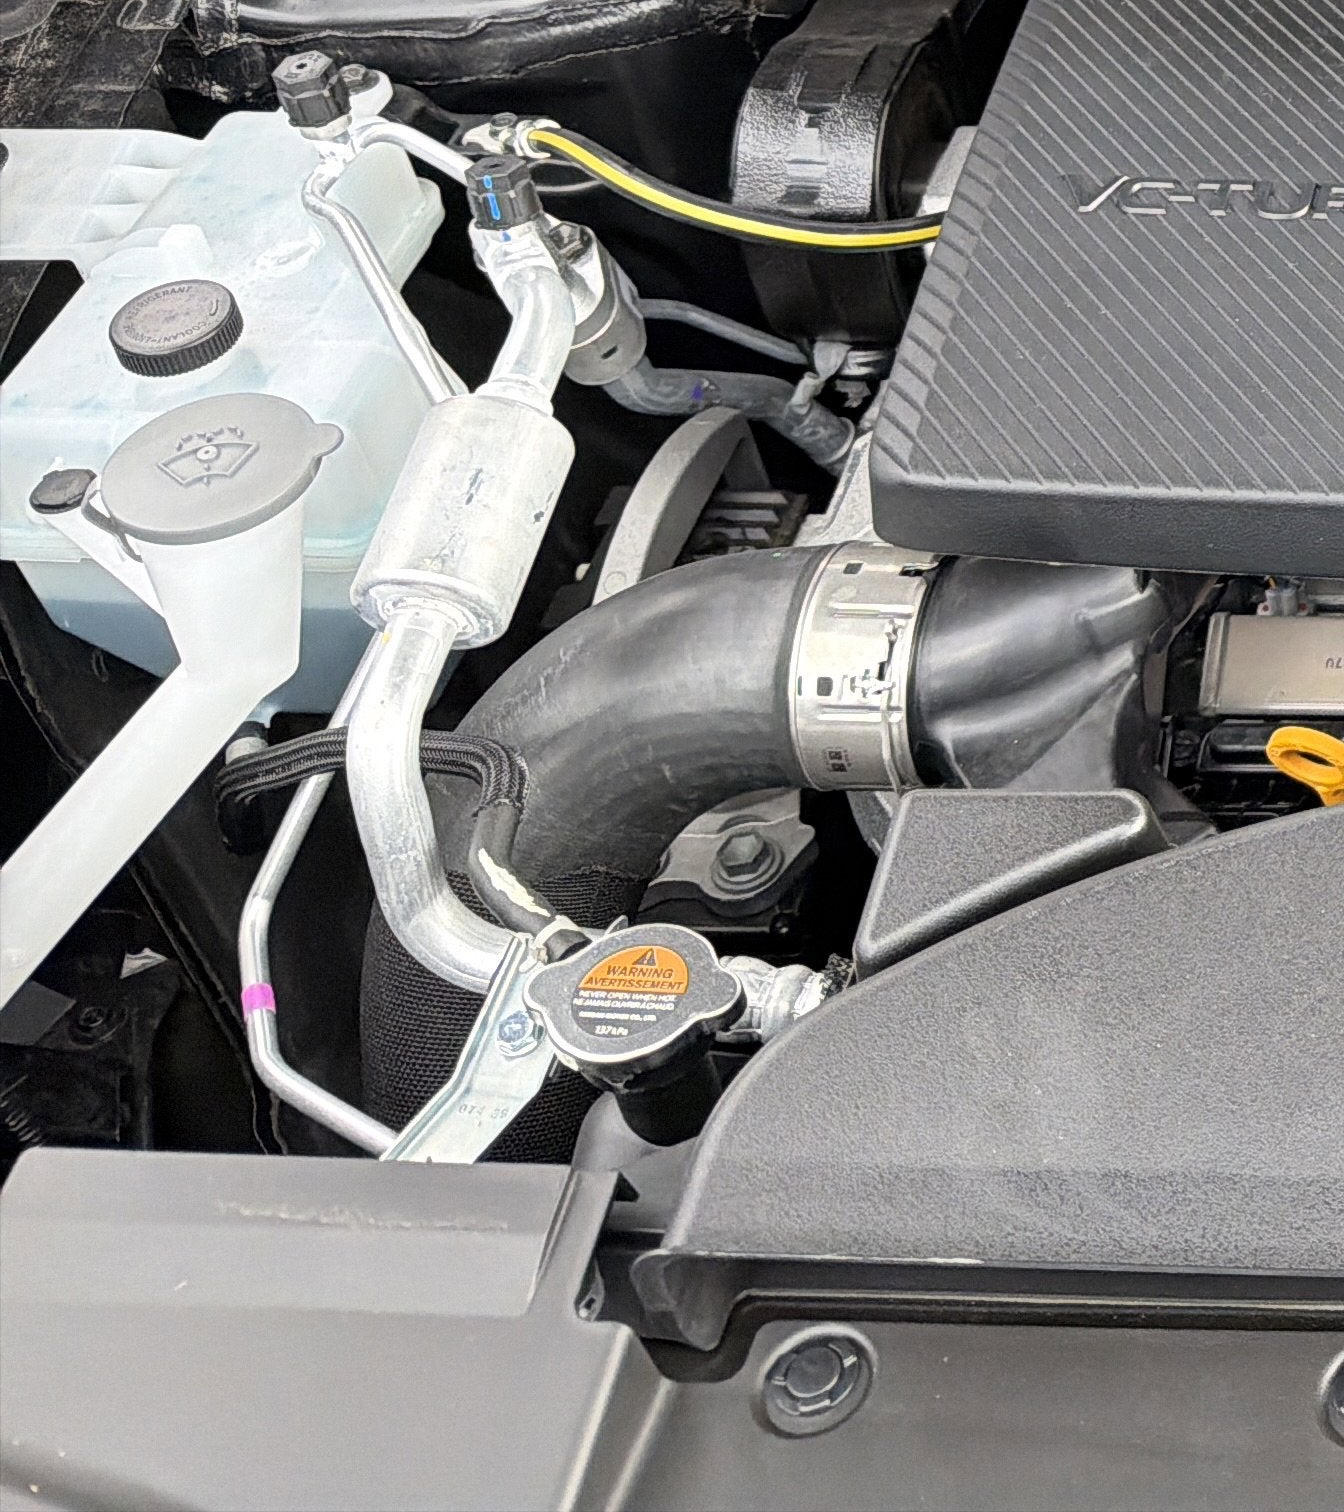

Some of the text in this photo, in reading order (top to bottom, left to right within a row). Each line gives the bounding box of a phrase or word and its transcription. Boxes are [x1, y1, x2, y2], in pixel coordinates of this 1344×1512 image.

[606, 965, 674, 979] WARNING
[584, 977, 685, 990] AVERTISSEMENT
[579, 990, 607, 999] NEVER
[607, 992, 631, 1000] OPEN
